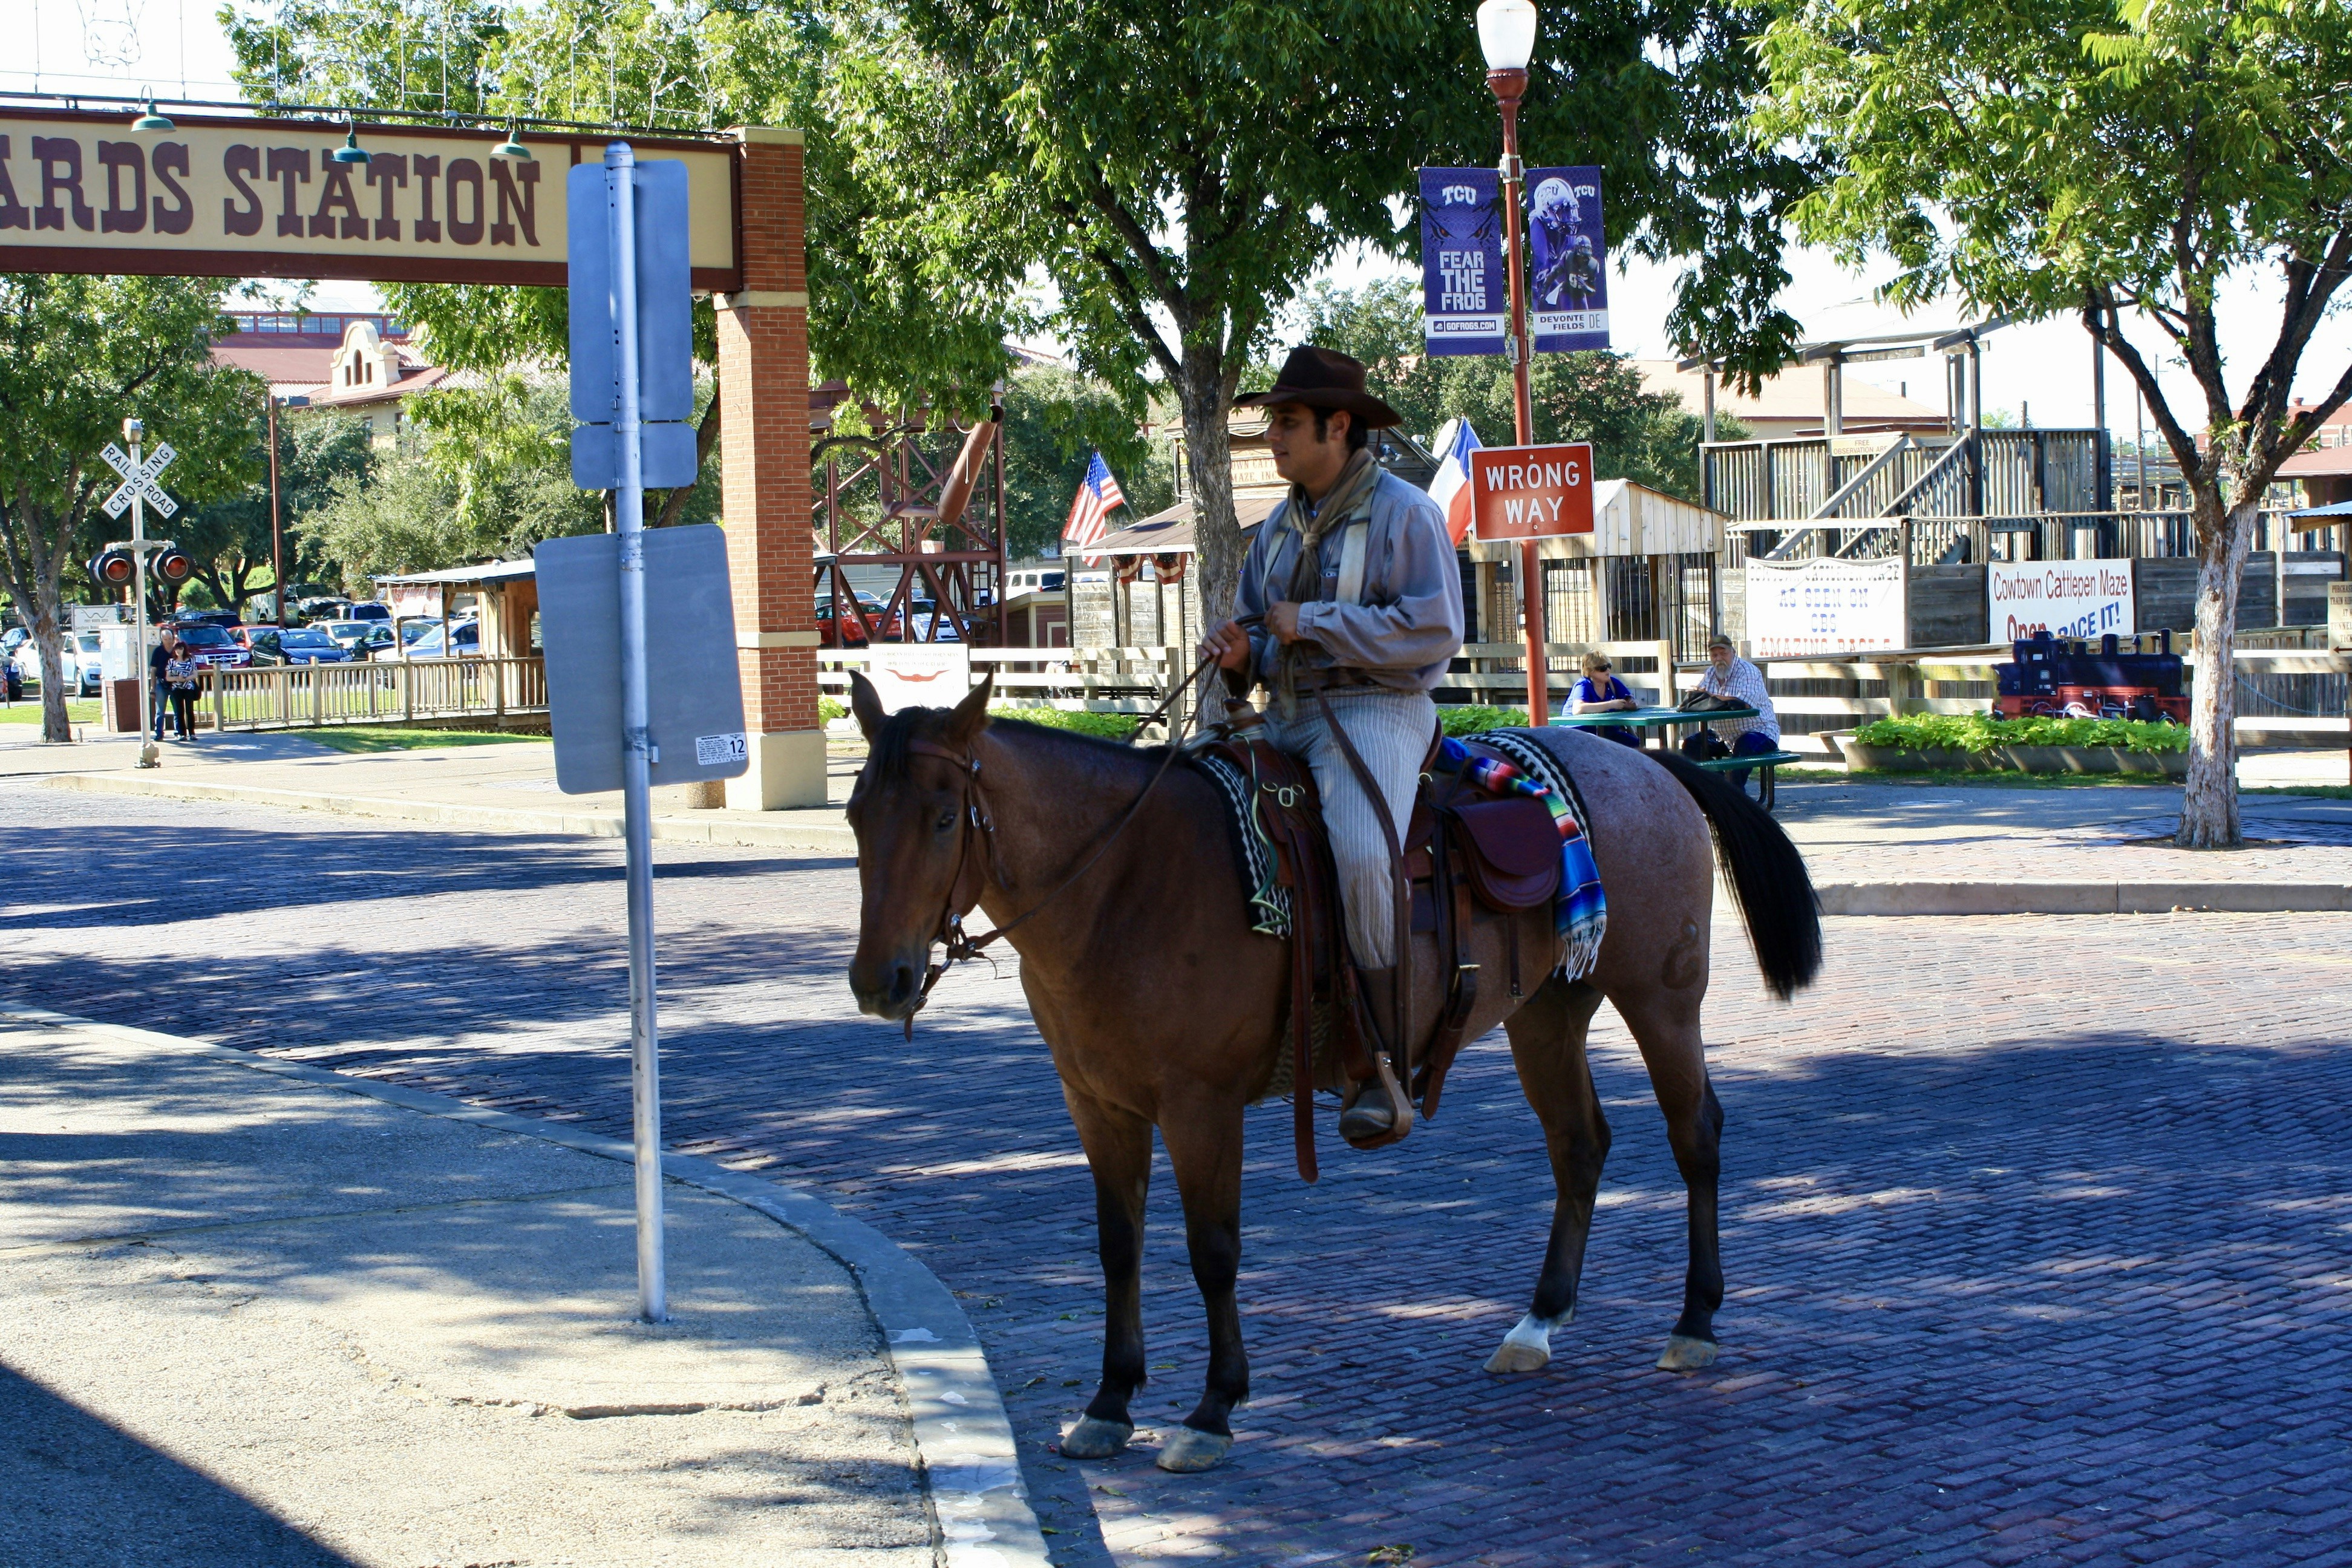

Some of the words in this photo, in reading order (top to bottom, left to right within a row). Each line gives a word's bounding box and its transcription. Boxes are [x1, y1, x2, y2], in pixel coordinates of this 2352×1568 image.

[224, 143, 541, 247] STATION
[1442, 185, 1477, 205] TCU
[1574, 185, 1595, 198] TCU
[1439, 251, 1484, 269] FEAR
[1440, 269, 1485, 293] THE
[1441, 293, 1486, 311] FROG
[1446, 321, 1495, 331] GOFROGS.COM
[1540, 314, 1584, 323] DEVONTE
[1553, 322, 1585, 330] FIELDS
[1589, 313, 1601, 328] DE
[104, 447, 131, 477] RAIL
[110, 449, 170, 512] CROSSING
[1485, 461, 1580, 492] WRONG
[143, 485, 174, 514] ROAD
[1504, 496, 1564, 524] WAY
[1993, 570, 2042, 601] Cowtown
[2045, 569, 2096, 604] Cattlepen
[2099, 569, 2128, 596] Maze
[1779, 587, 1796, 607] AS
[1805, 588, 1841, 607] SEEN
[1850, 588, 1868, 607] ON
[1811, 613, 1836, 633] CBS
[2100, 601, 2120, 630] IT!
[1760, 637, 1828, 658] AMAZING
[730, 739, 745, 754] 12
